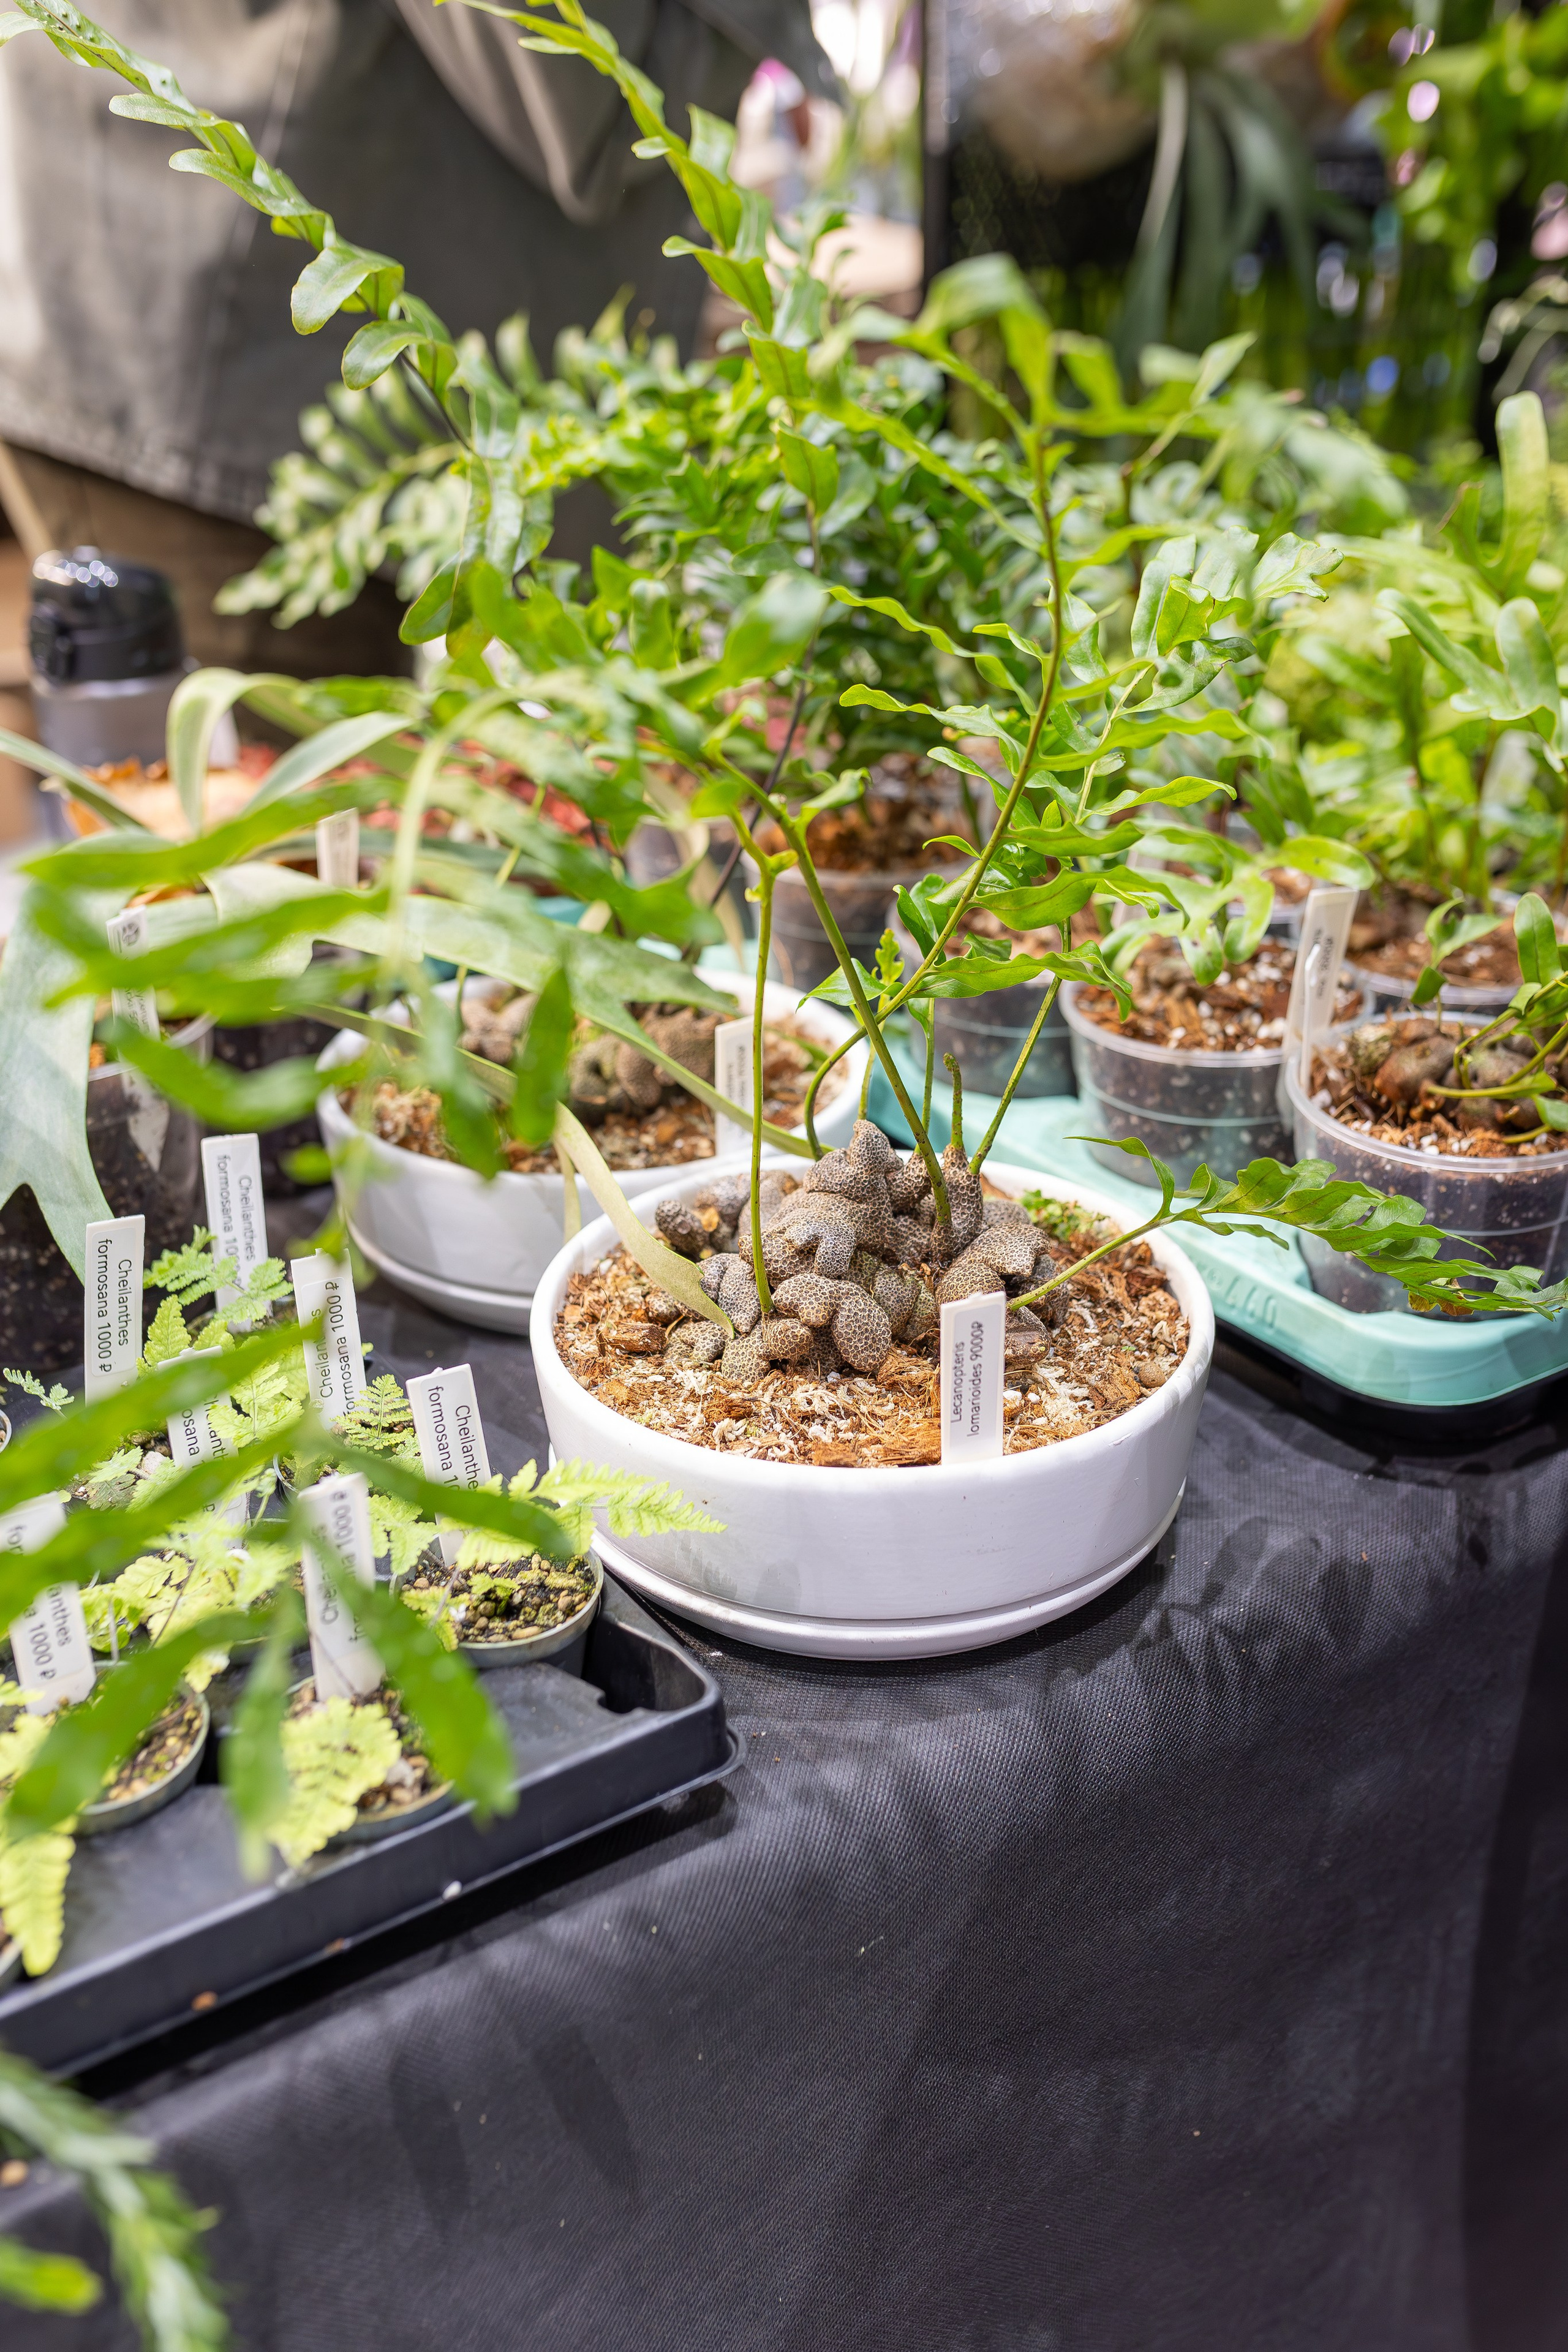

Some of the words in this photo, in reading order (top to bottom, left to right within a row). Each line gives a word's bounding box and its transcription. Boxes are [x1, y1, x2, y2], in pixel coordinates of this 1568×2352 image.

[217, 1154, 233, 1233] formosana
[238, 1175, 256, 1262] Cheilanthes
[97, 1238, 113, 1318] formosana
[118, 1259, 132, 1347] Cheilanthes
[326, 1295, 345, 1332] 1000
[98, 1322, 112, 1359] 1000
[951, 1341, 965, 1423] Lecanopteris
[181, 1409, 200, 1457] osana
[428, 1385, 452, 1471] formosana
[455, 1405, 481, 1491] Cheilanthe
[333, 1504, 355, 1550] 1000
[29, 1623, 53, 1666] 1000
[47, 1586, 73, 1648] anthes
